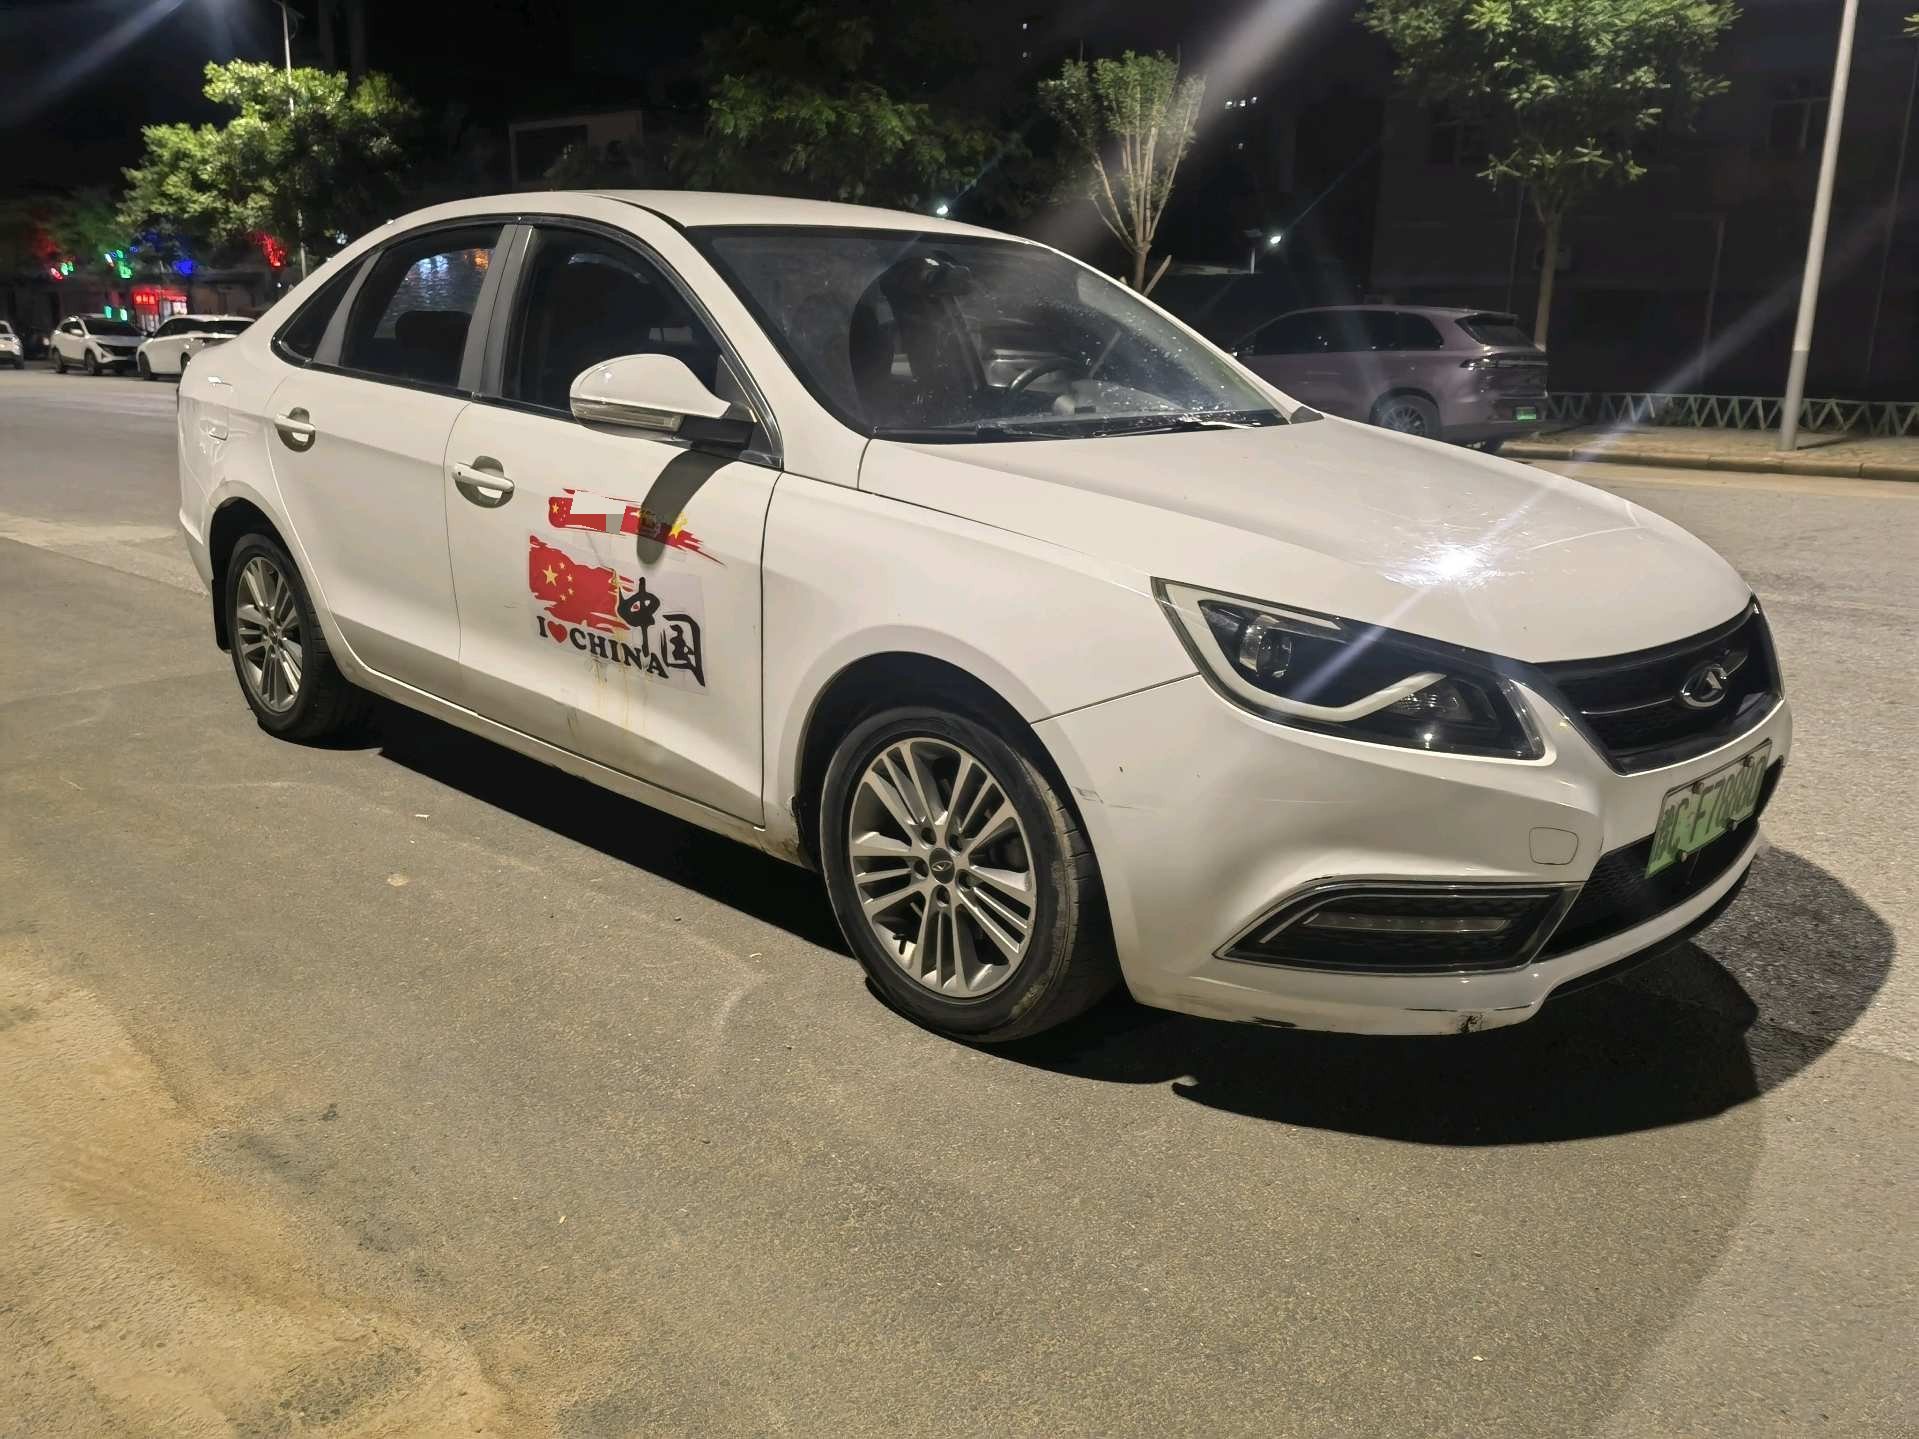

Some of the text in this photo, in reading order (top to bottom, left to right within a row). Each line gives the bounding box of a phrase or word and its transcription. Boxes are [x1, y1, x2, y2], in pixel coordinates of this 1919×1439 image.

[536, 615, 669, 679] I CHINA
[618, 577, 706, 687] 中国
